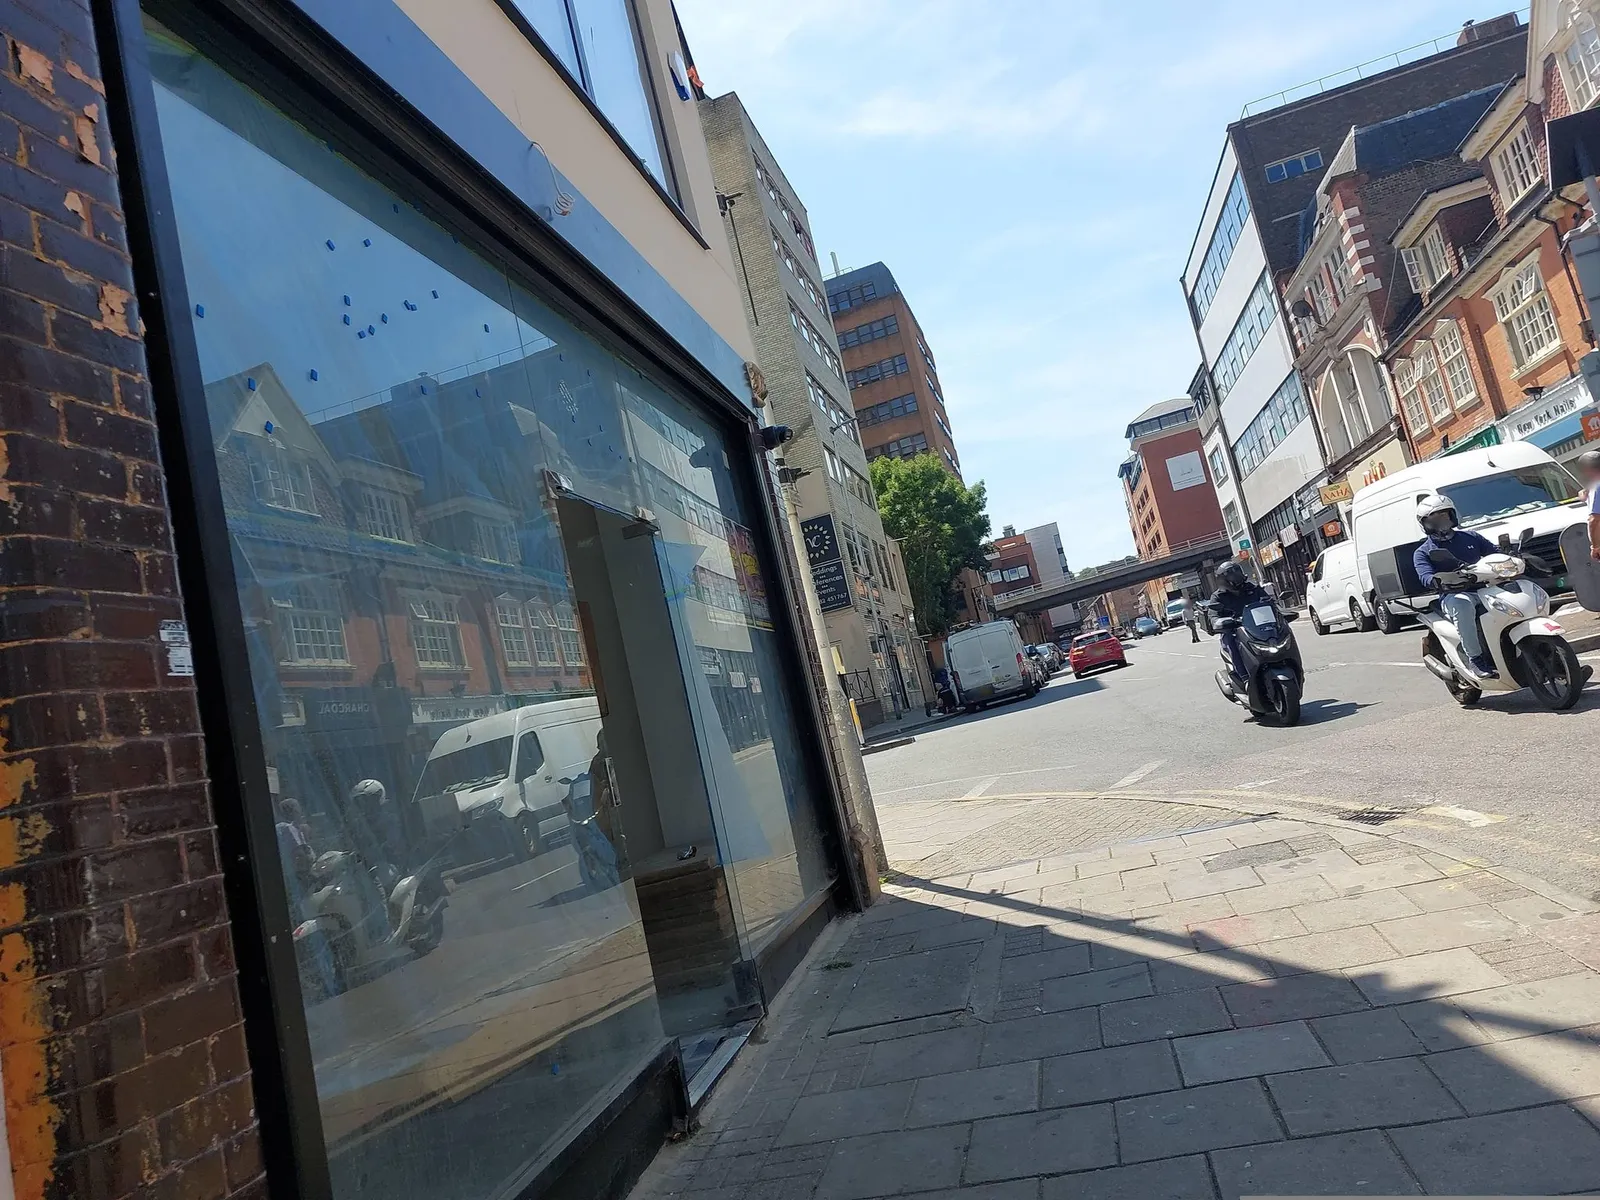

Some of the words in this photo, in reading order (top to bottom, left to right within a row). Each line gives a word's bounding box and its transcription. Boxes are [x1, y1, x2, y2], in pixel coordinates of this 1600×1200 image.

[1517, 420, 1533, 434] New
[1534, 409, 1552, 424] York
[1553, 398, 1576, 416] Nails
[813, 565, 838, 576] eddings
